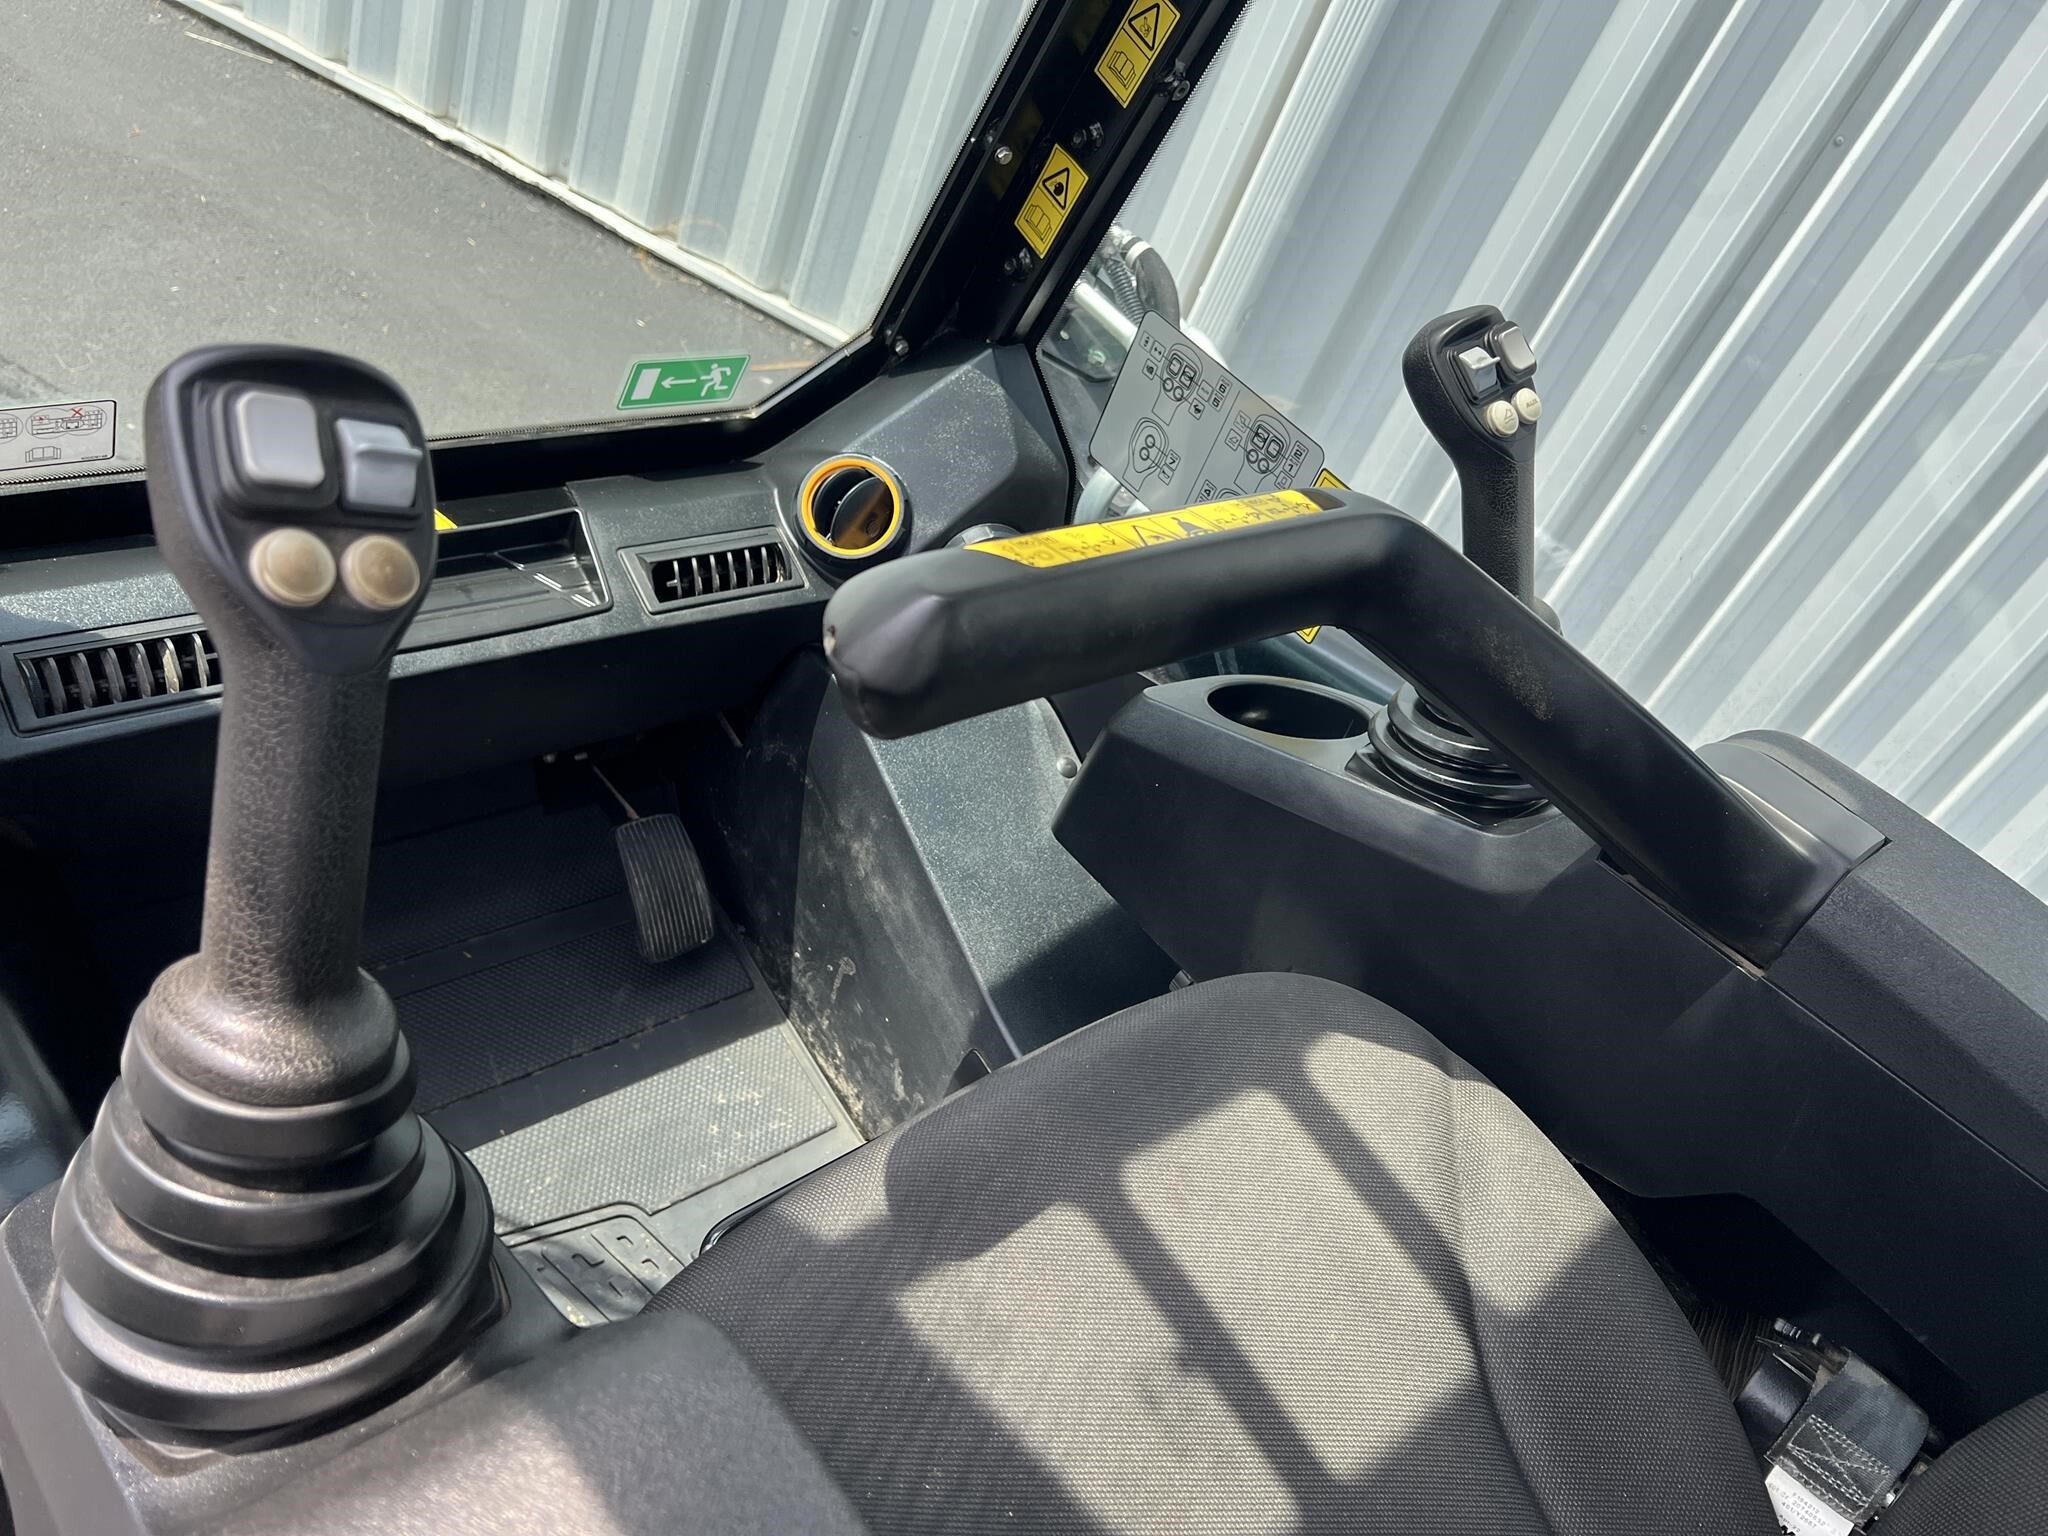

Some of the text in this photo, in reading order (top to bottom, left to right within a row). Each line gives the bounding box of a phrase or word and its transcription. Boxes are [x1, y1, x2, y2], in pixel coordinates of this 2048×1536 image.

[1219, 383, 1227, 394] 6
[1293, 449, 1303, 460] 2
[1169, 457, 1176, 465] 7
[1287, 463, 1294, 472] 1
